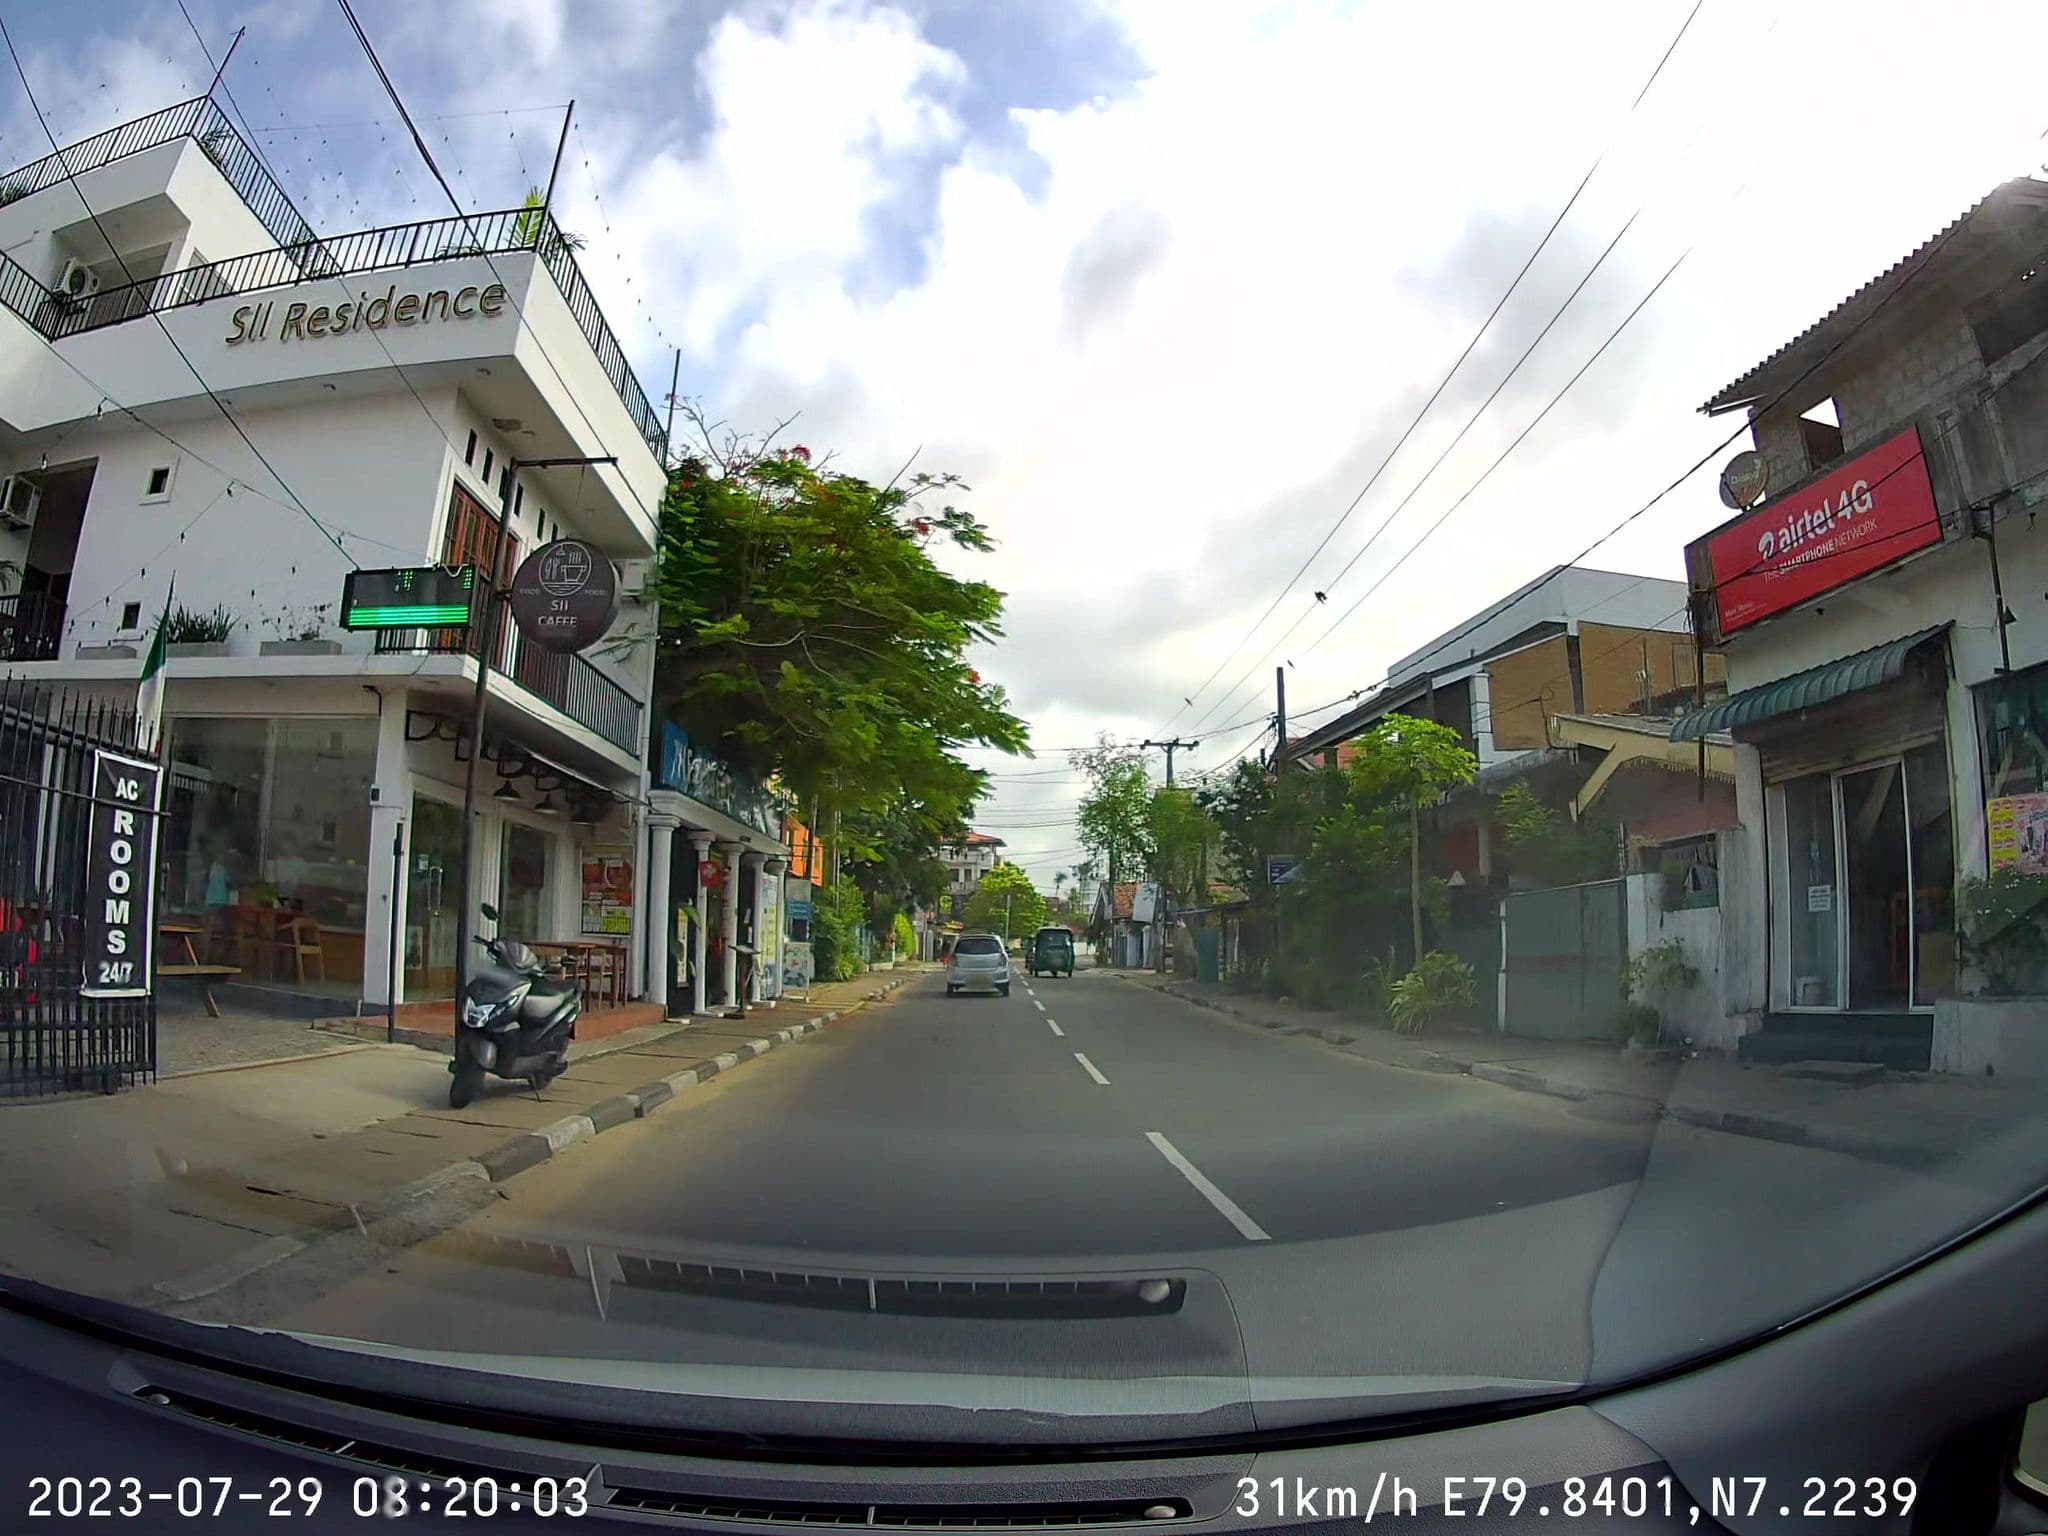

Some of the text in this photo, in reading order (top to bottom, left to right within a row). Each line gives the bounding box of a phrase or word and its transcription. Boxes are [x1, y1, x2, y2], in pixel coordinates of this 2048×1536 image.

[280, 282, 506, 343] Residence
[1779, 480, 1873, 553] airtel 4G
[1834, 518, 1878, 548] NETWORK
[115, 777, 139, 801] AC
[105, 810, 134, 954] ROOMS
[99, 961, 133, 983] 24/7
